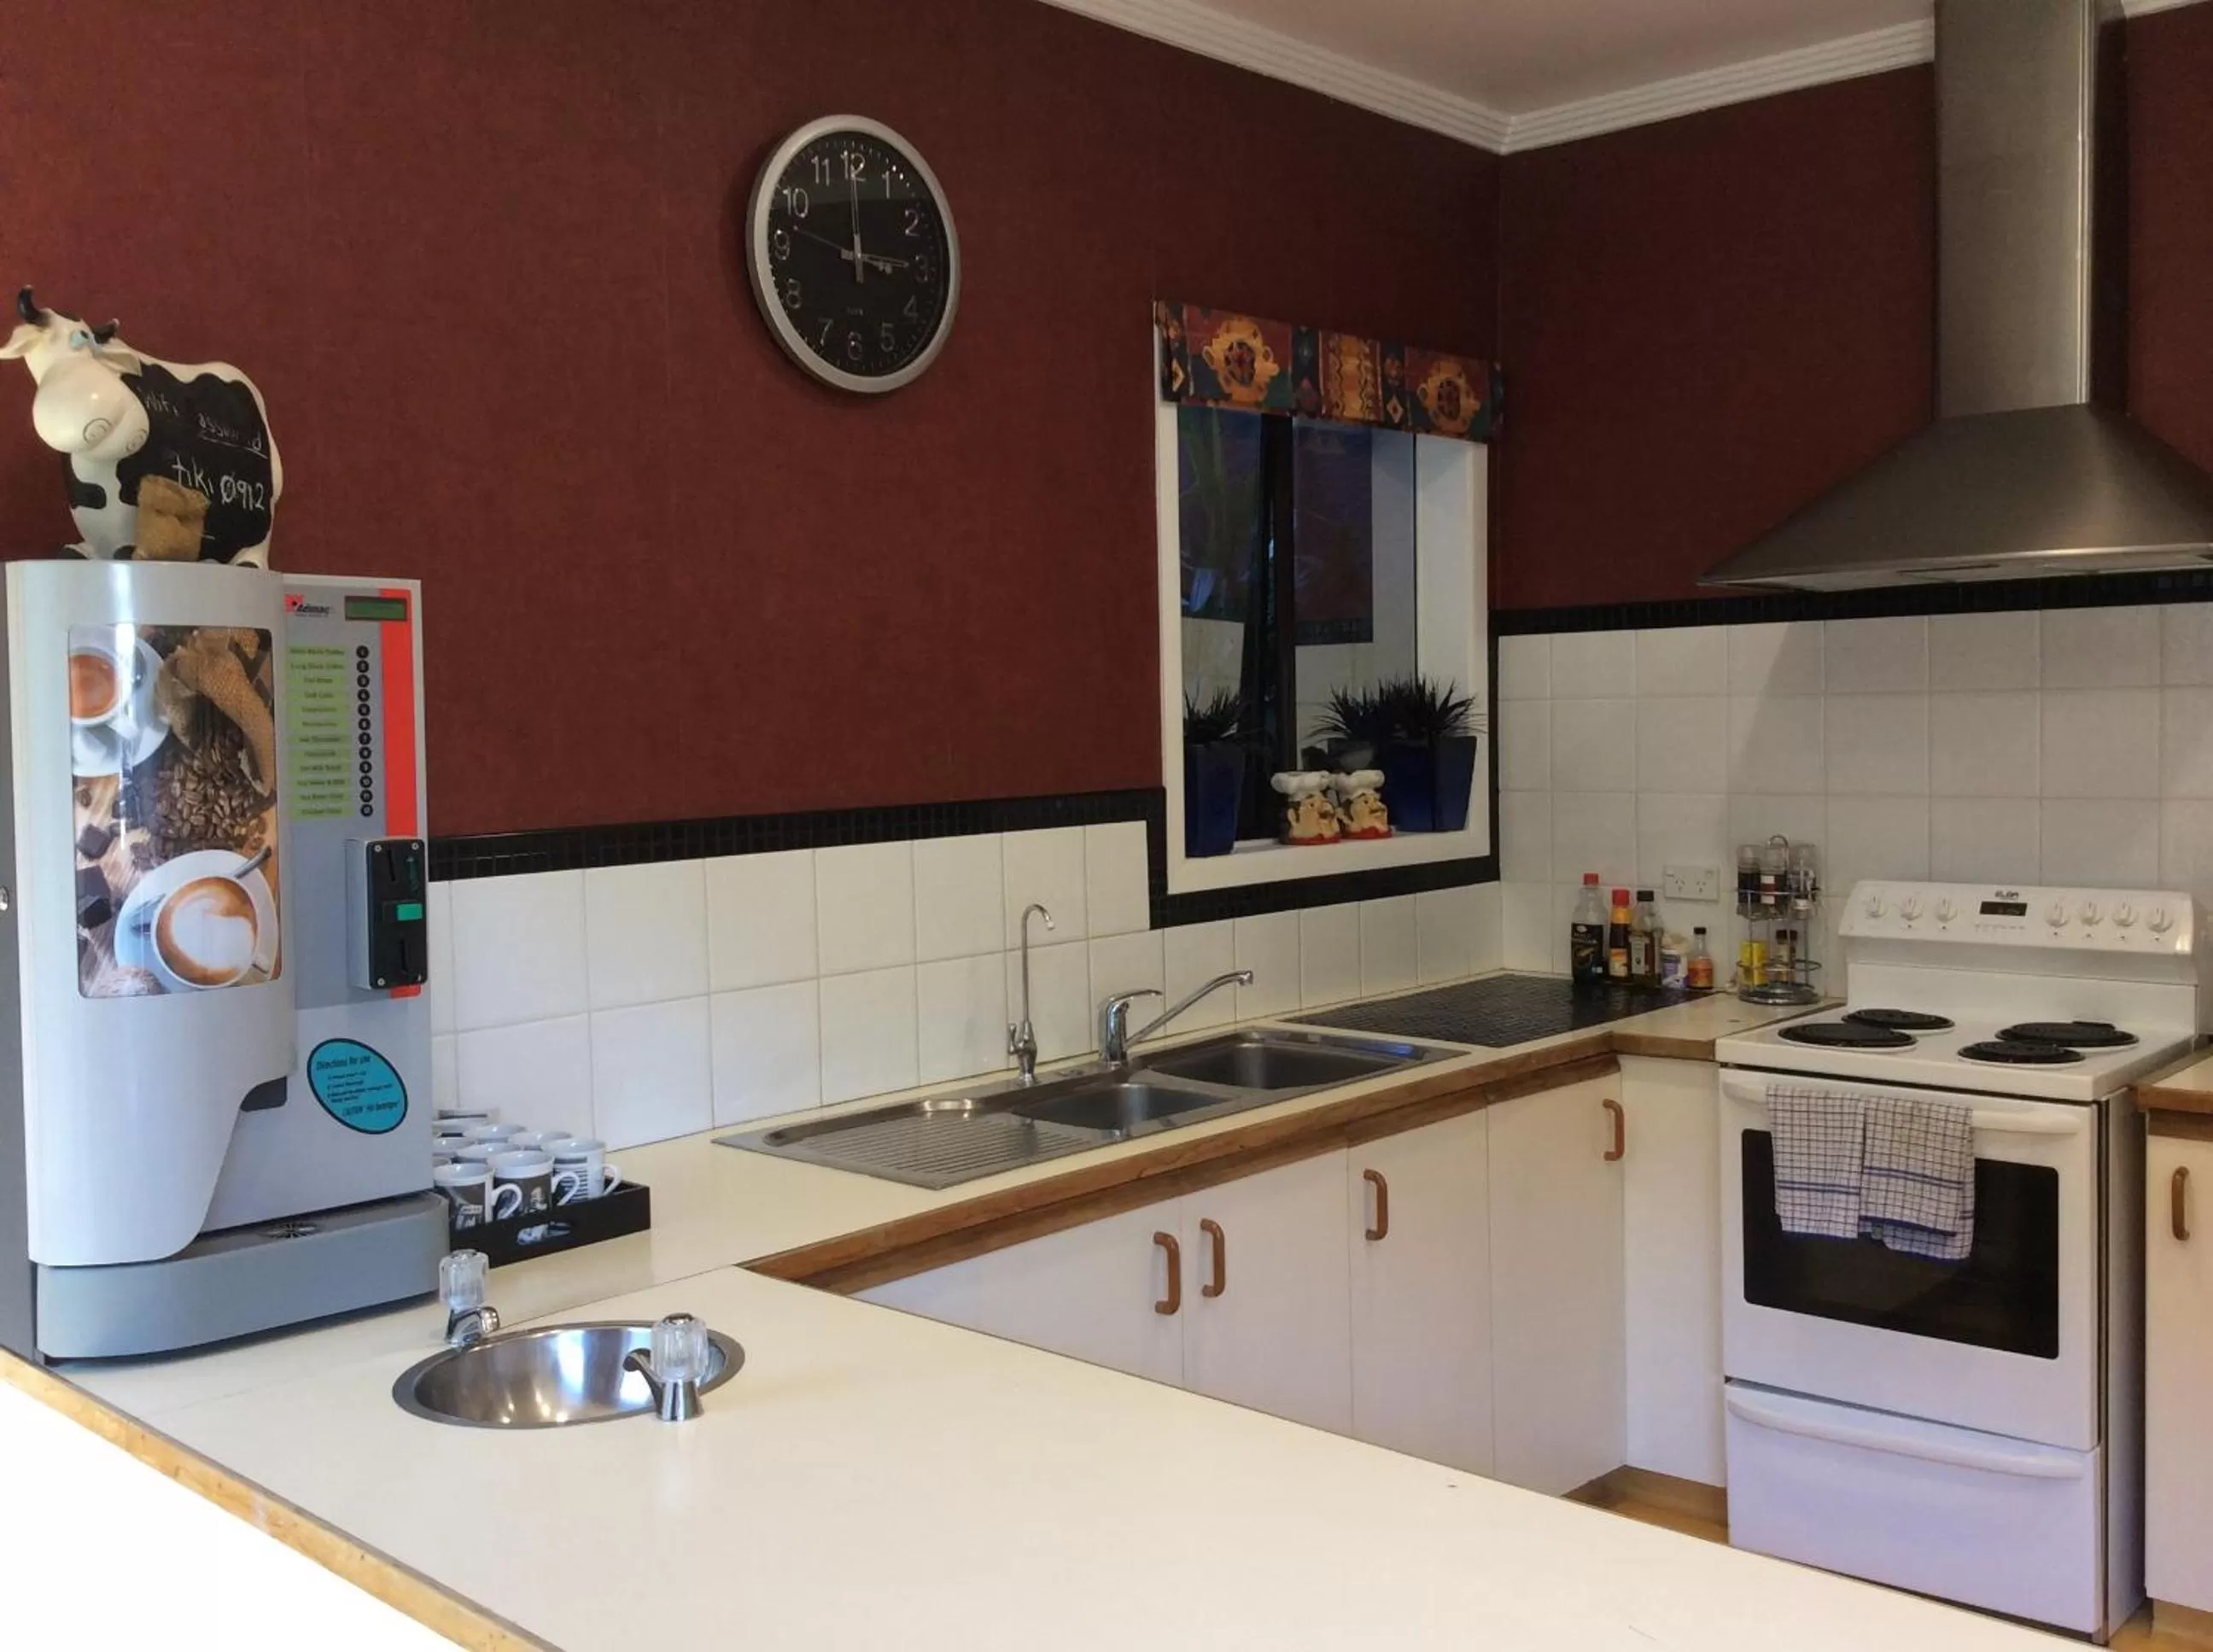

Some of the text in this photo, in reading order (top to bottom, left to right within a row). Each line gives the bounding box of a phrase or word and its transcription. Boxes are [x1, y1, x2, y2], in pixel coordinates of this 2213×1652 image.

[810, 156, 831, 187] 11
[840, 149, 867, 183] 12
[881, 170, 891, 199] 1
[782, 188, 809, 219] 10
[904, 209, 920, 237] 2
[774, 229, 791, 260] 9
[914, 255, 929, 283] 3
[785, 278, 803, 310] 8
[902, 295, 920, 318] 4
[817, 318, 834, 347] 7
[847, 331, 863, 360] 6
[879, 323, 896, 352] 5
